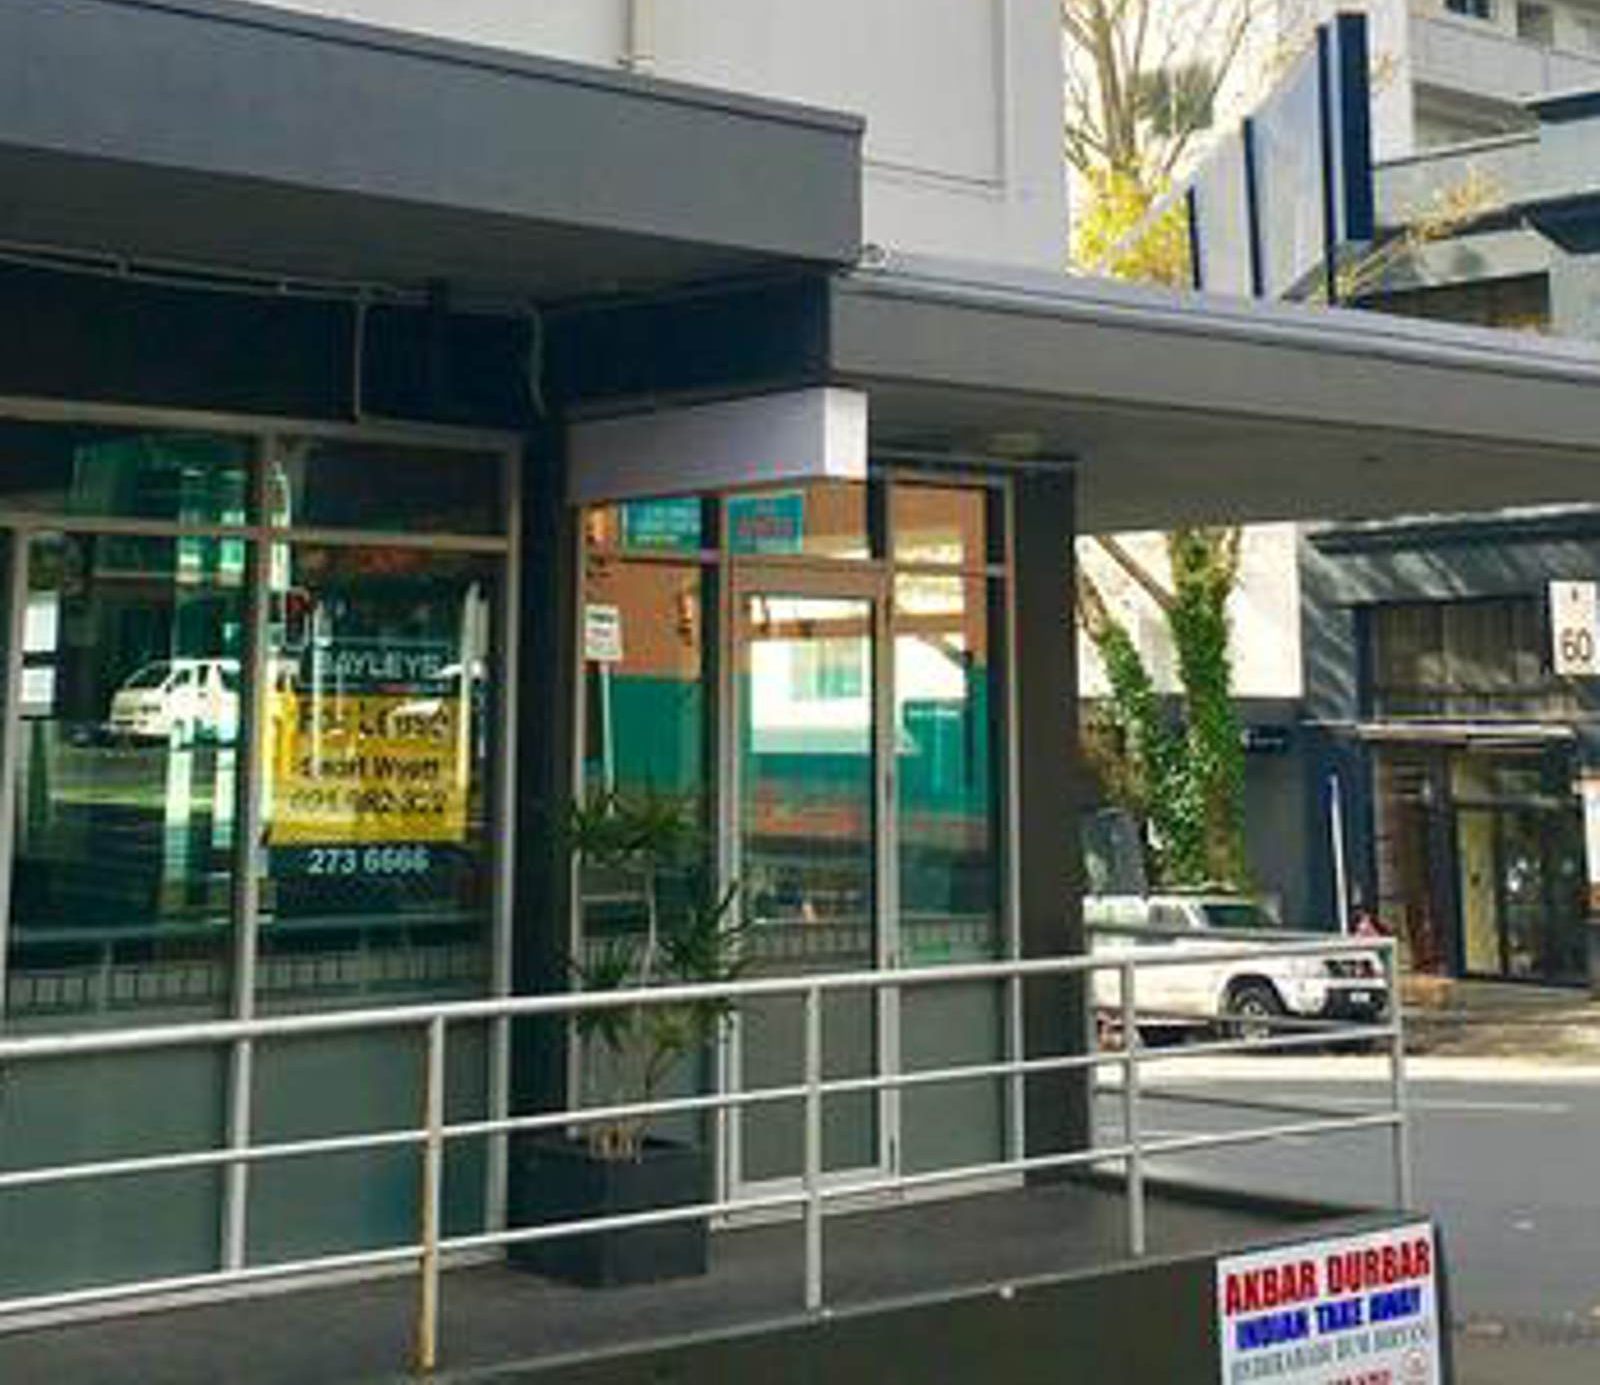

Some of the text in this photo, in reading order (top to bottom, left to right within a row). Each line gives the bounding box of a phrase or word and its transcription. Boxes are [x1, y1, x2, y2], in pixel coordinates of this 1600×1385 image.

[1561, 627, 1595, 663] 60
[307, 847, 357, 875] 273
[1226, 1236, 1431, 1318] AKBAR DURBAR
